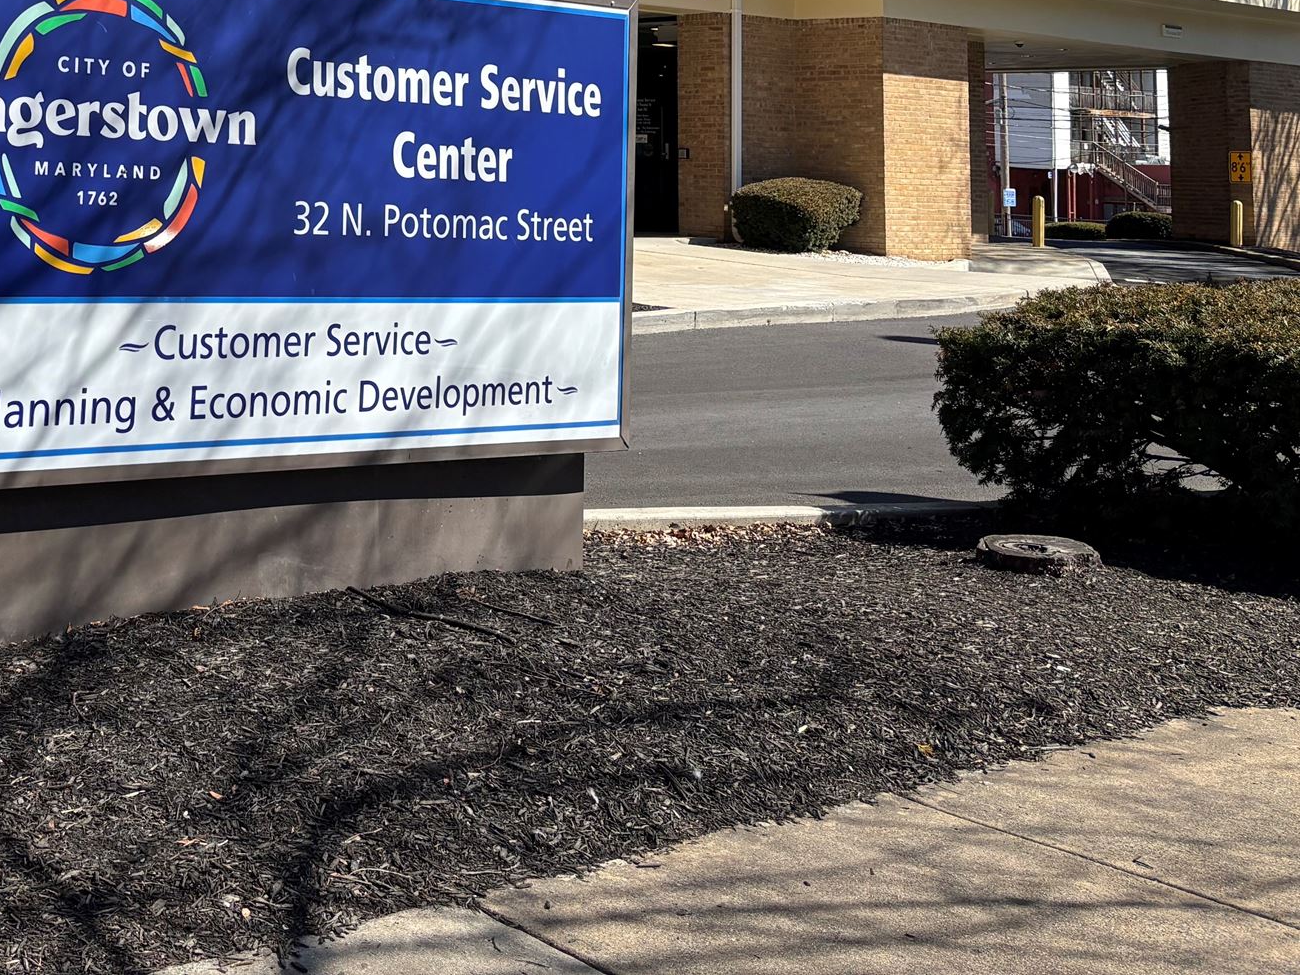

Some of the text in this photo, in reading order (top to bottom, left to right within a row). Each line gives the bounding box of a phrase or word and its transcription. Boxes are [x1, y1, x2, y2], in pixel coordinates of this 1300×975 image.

[57, 55, 150, 78] CITY OF
[287, 47, 603, 118] Customer Service
[34, 160, 161, 181] MARYLAND
[392, 130, 514, 184] Center
[76, 190, 118, 206] 1762
[293, 200, 594, 243] 32 N. Potomac Street
[154, 323, 432, 361] Customer Service
[151, 386, 176, 422] &
[189, 380, 348, 421] Economic
[358, 375, 554, 416] Development
